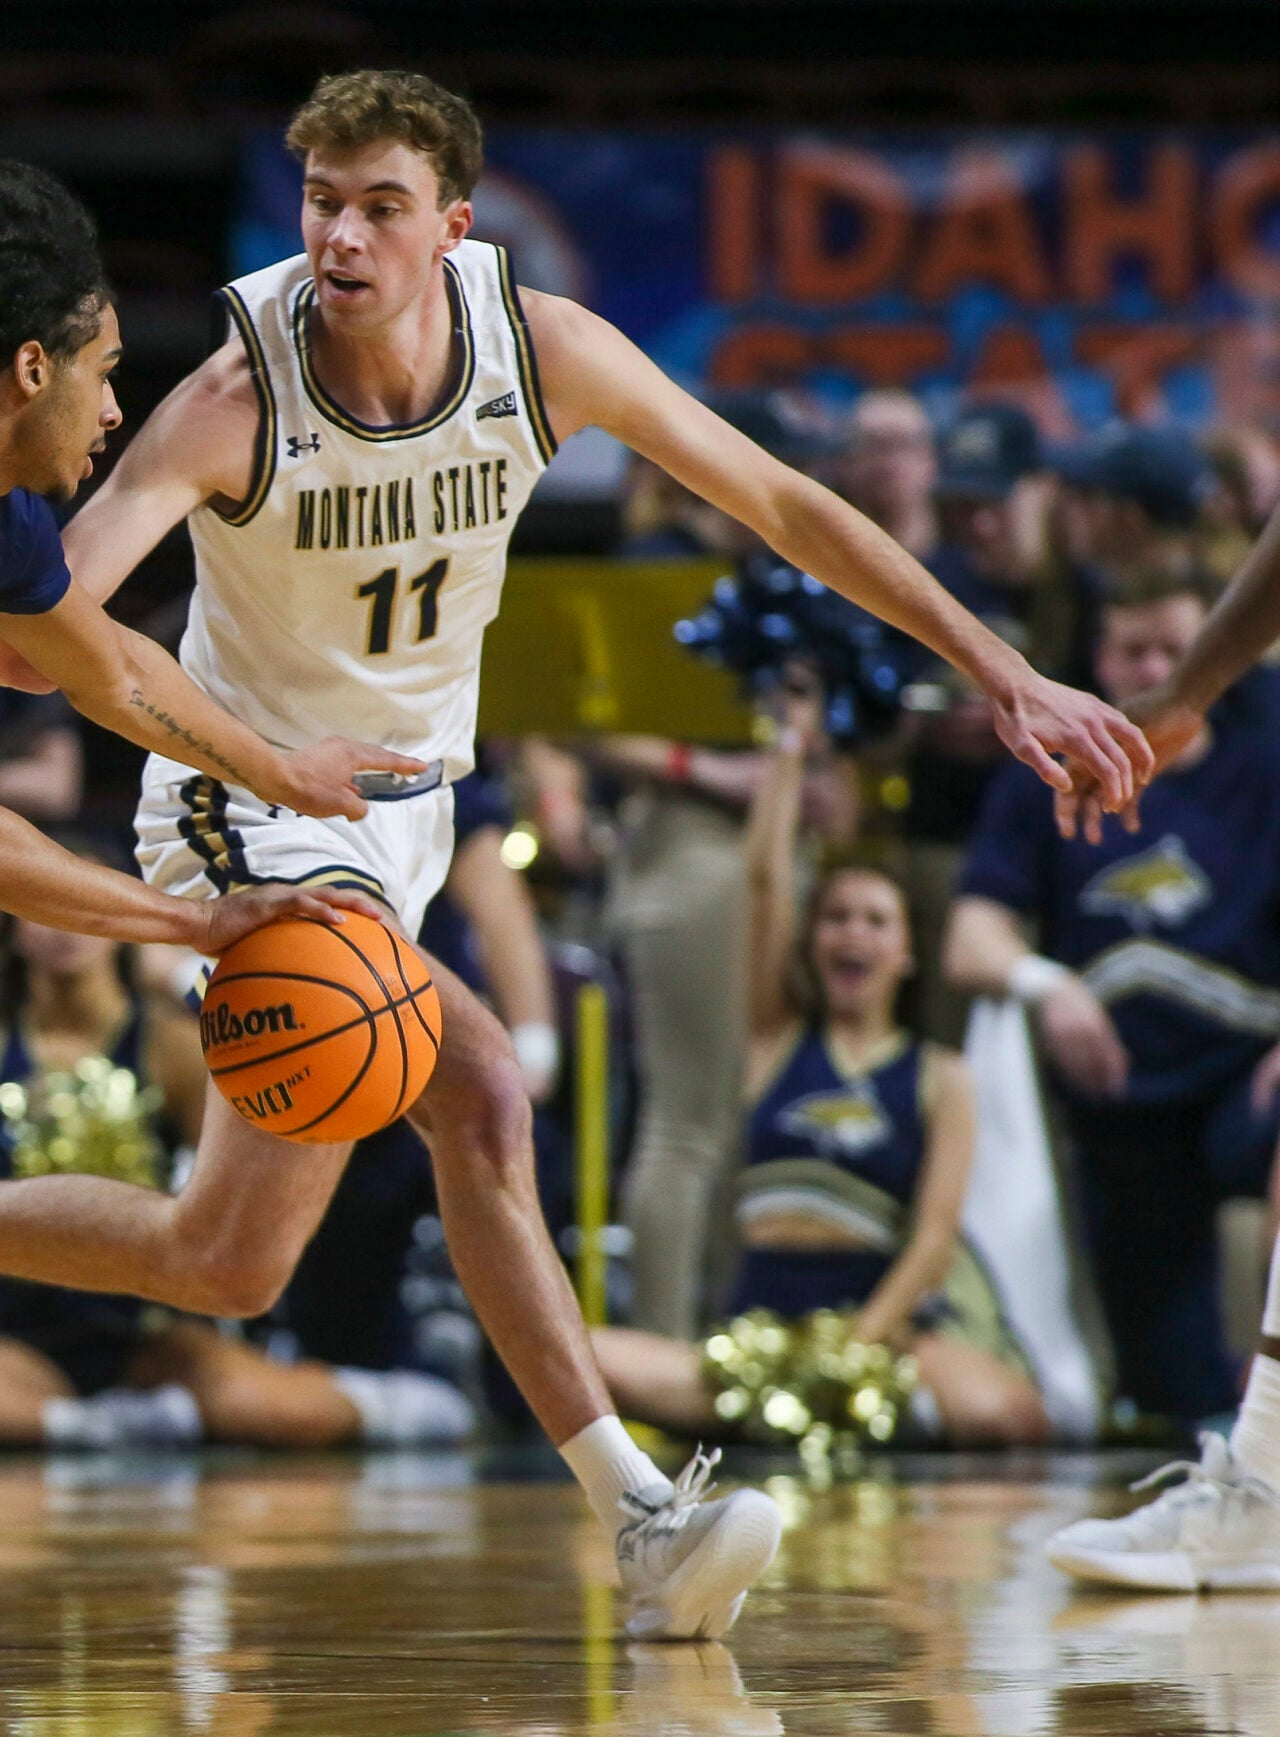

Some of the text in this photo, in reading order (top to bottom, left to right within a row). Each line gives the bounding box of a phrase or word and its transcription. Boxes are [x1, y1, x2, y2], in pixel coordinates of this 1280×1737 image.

[295, 459, 508, 550] MONTANA STATE
[356, 558, 452, 655] 11
